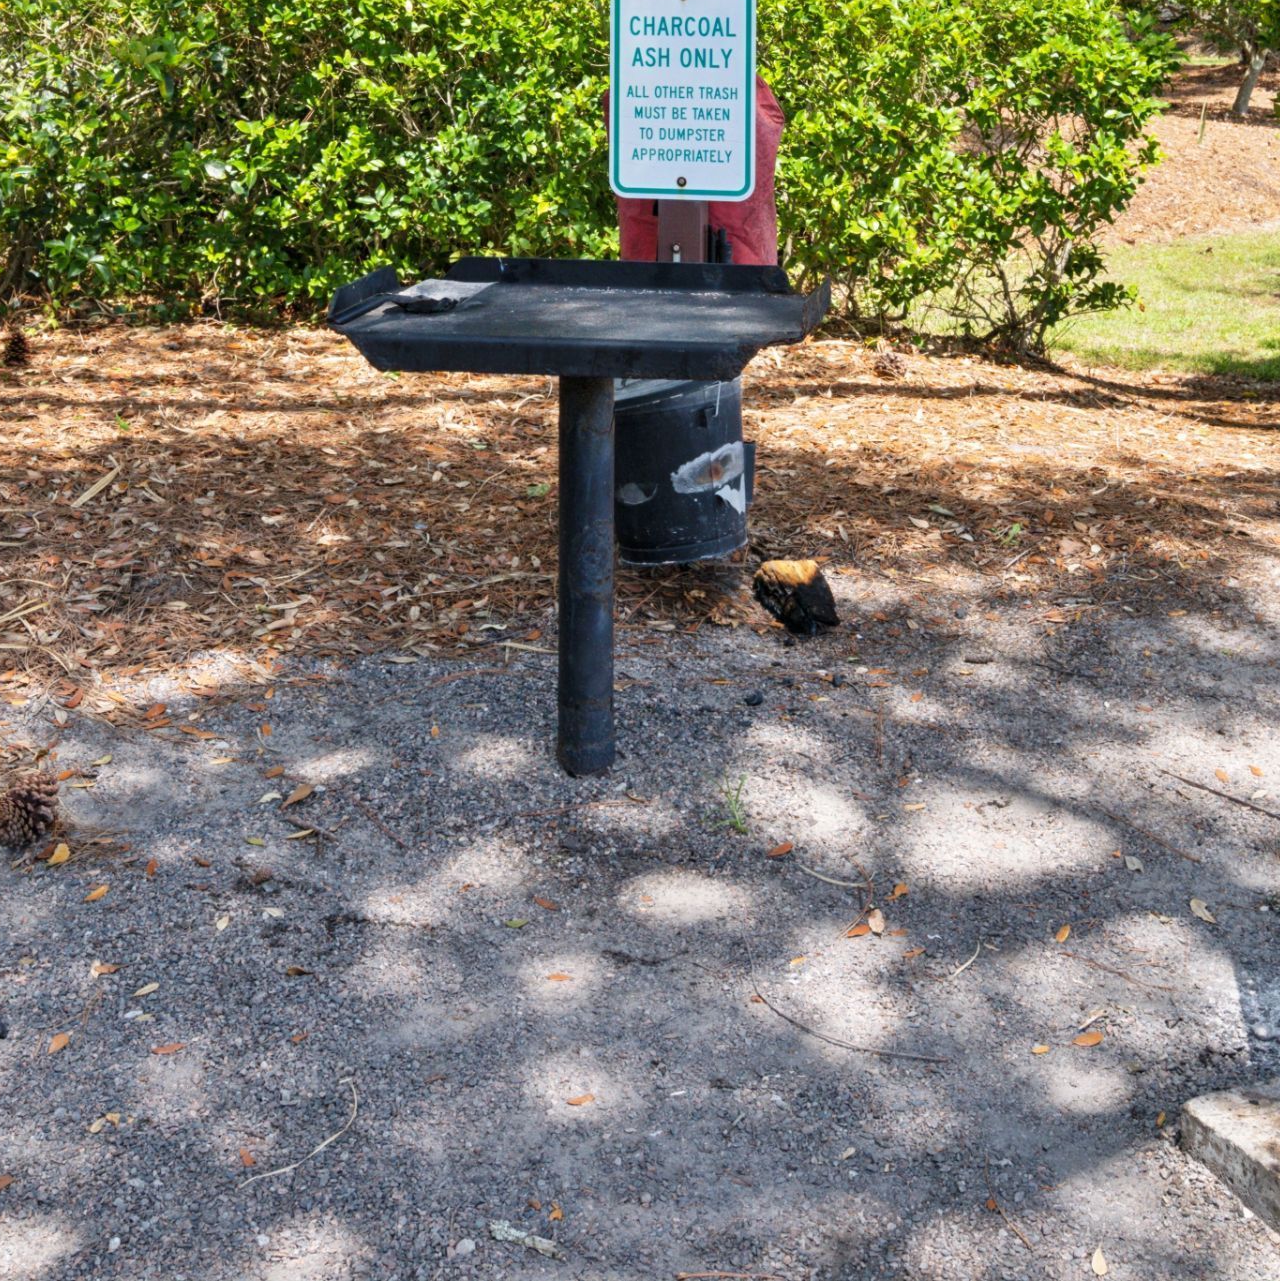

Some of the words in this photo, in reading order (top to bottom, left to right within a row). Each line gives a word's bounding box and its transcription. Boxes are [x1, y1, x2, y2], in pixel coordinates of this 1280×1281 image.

[629, 15, 737, 37] CHARCOAL
[631, 47, 670, 67] ASH
[680, 48, 733, 69] ONLY
[626, 85, 649, 98] ALL
[654, 86, 694, 99] OTHER
[699, 87, 738, 100] TRASH
[634, 106, 666, 119] MUST
[672, 107, 687, 120] BE
[692, 107, 730, 121] TAKEN
[639, 127, 653, 140] TO
[659, 128, 725, 142] DUMPSTER
[631, 147, 732, 163] APPROPRIATELY
